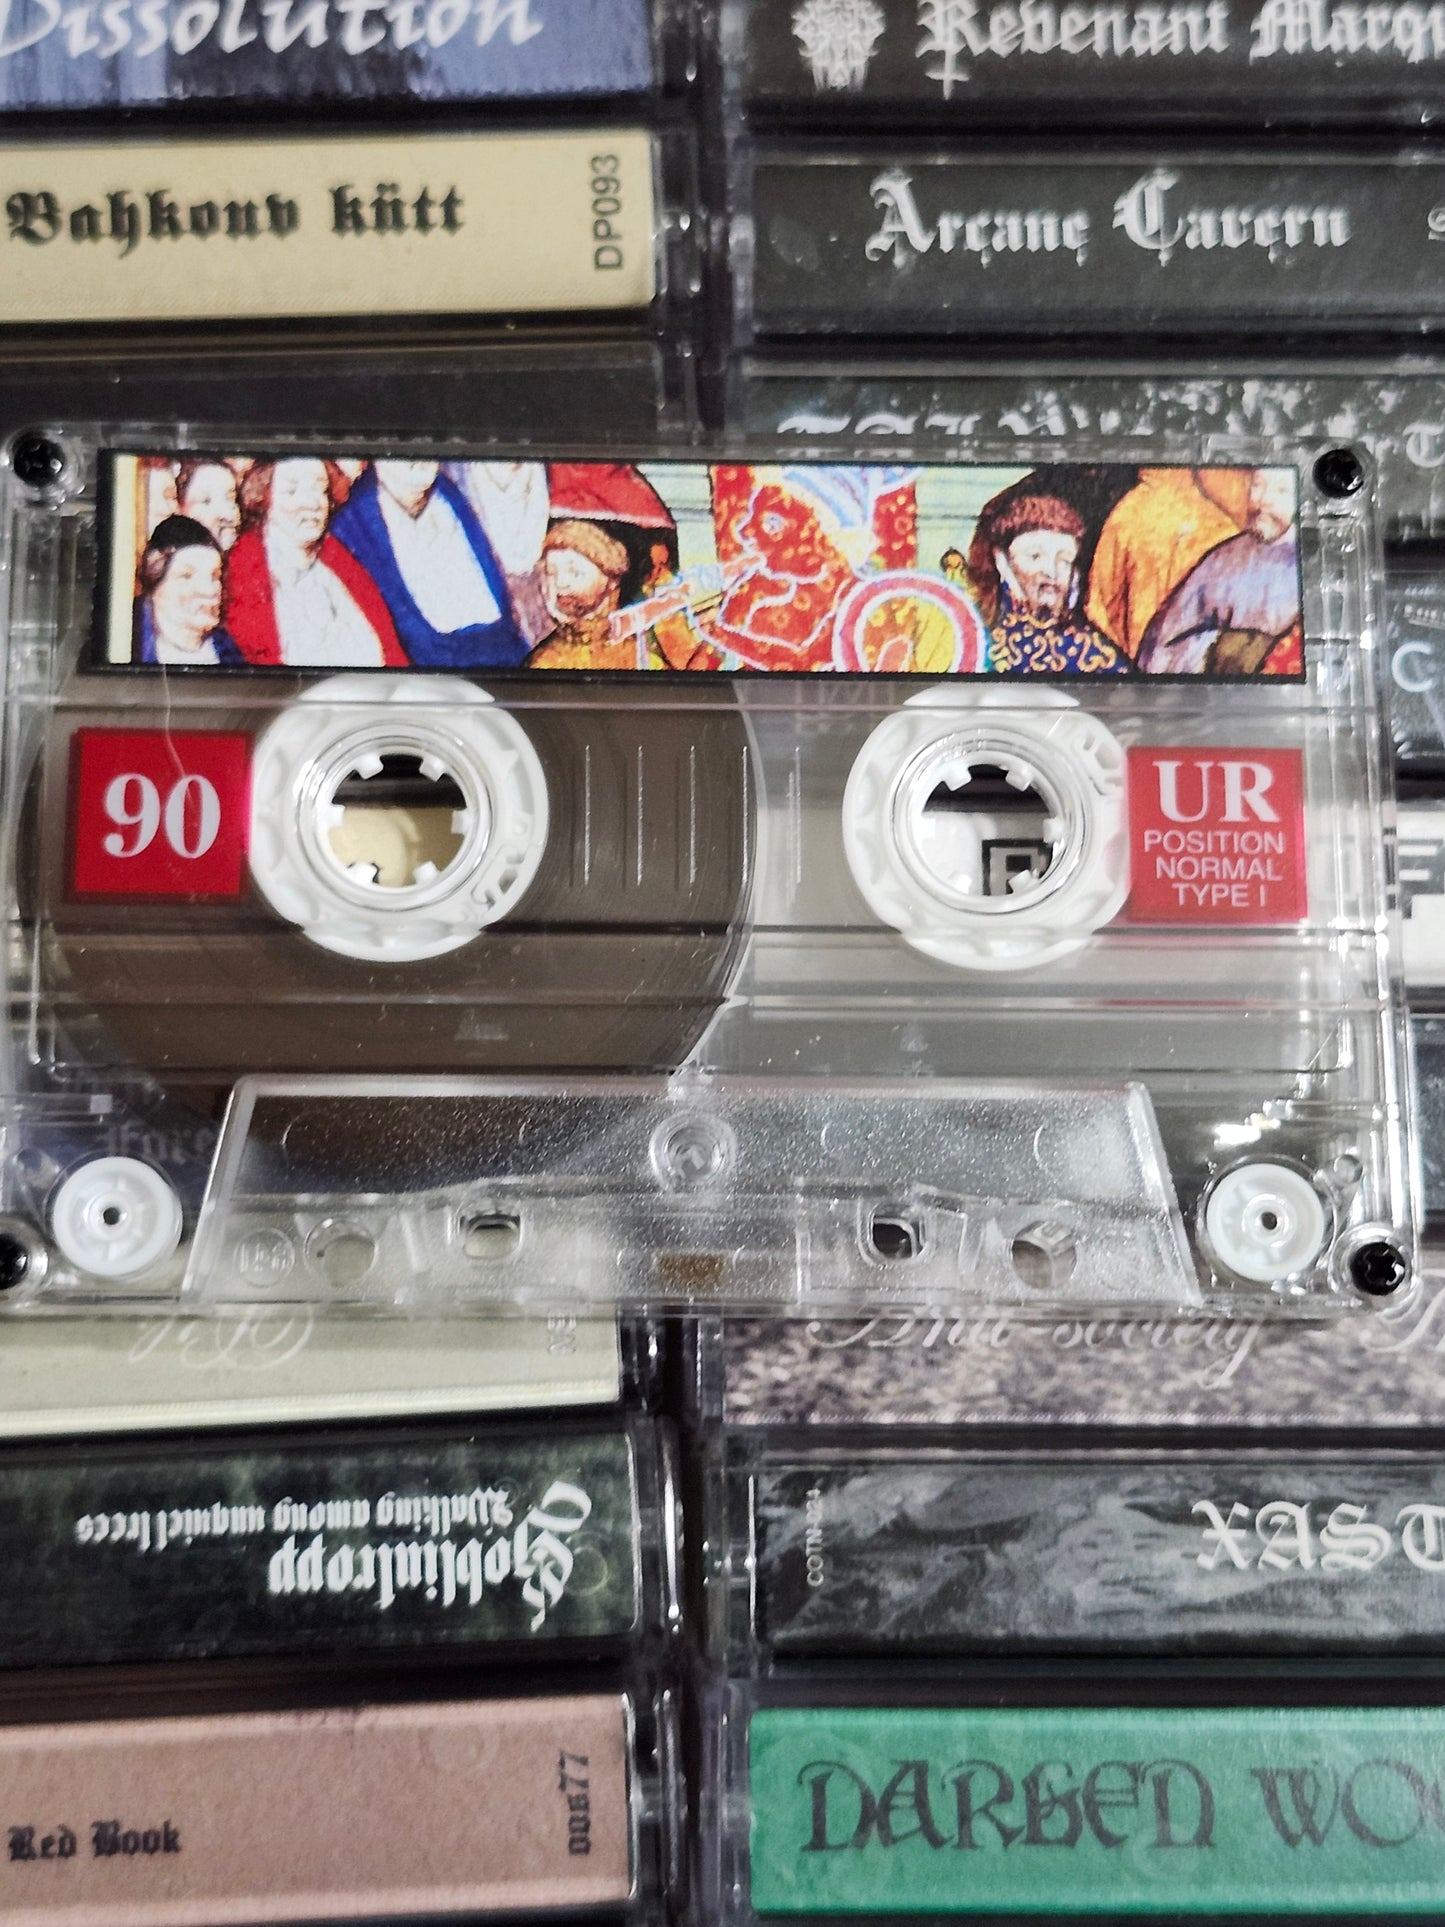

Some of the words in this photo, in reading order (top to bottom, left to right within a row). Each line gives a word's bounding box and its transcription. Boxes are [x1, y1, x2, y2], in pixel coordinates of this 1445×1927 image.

[915, 0, 1229, 100] Revenant
[591, 154, 622, 270] DP093
[865, 168, 1094, 268] Arcane
[1112, 166, 1352, 268] Cavern
[103, 773, 221, 859] 90
[1152, 760, 1280, 822] UR
[1143, 829, 1285, 855] POSITION
[1155, 856, 1283, 881] NORMAL
[1171, 882, 1249, 907] TYPE
[1258, 884, 1266, 907] I
[75, 1511, 151, 1553] trees
[157, 1501, 266, 1551] unquiet
[272, 1496, 371, 1532] among
[375, 1487, 514, 1536] Walking
[267, 1480, 592, 1632] Goblintropp
[1249, 1759, 1445, 1850] WO
[8, 1824, 77, 1861] Red
[91, 1819, 182, 1858] Book
